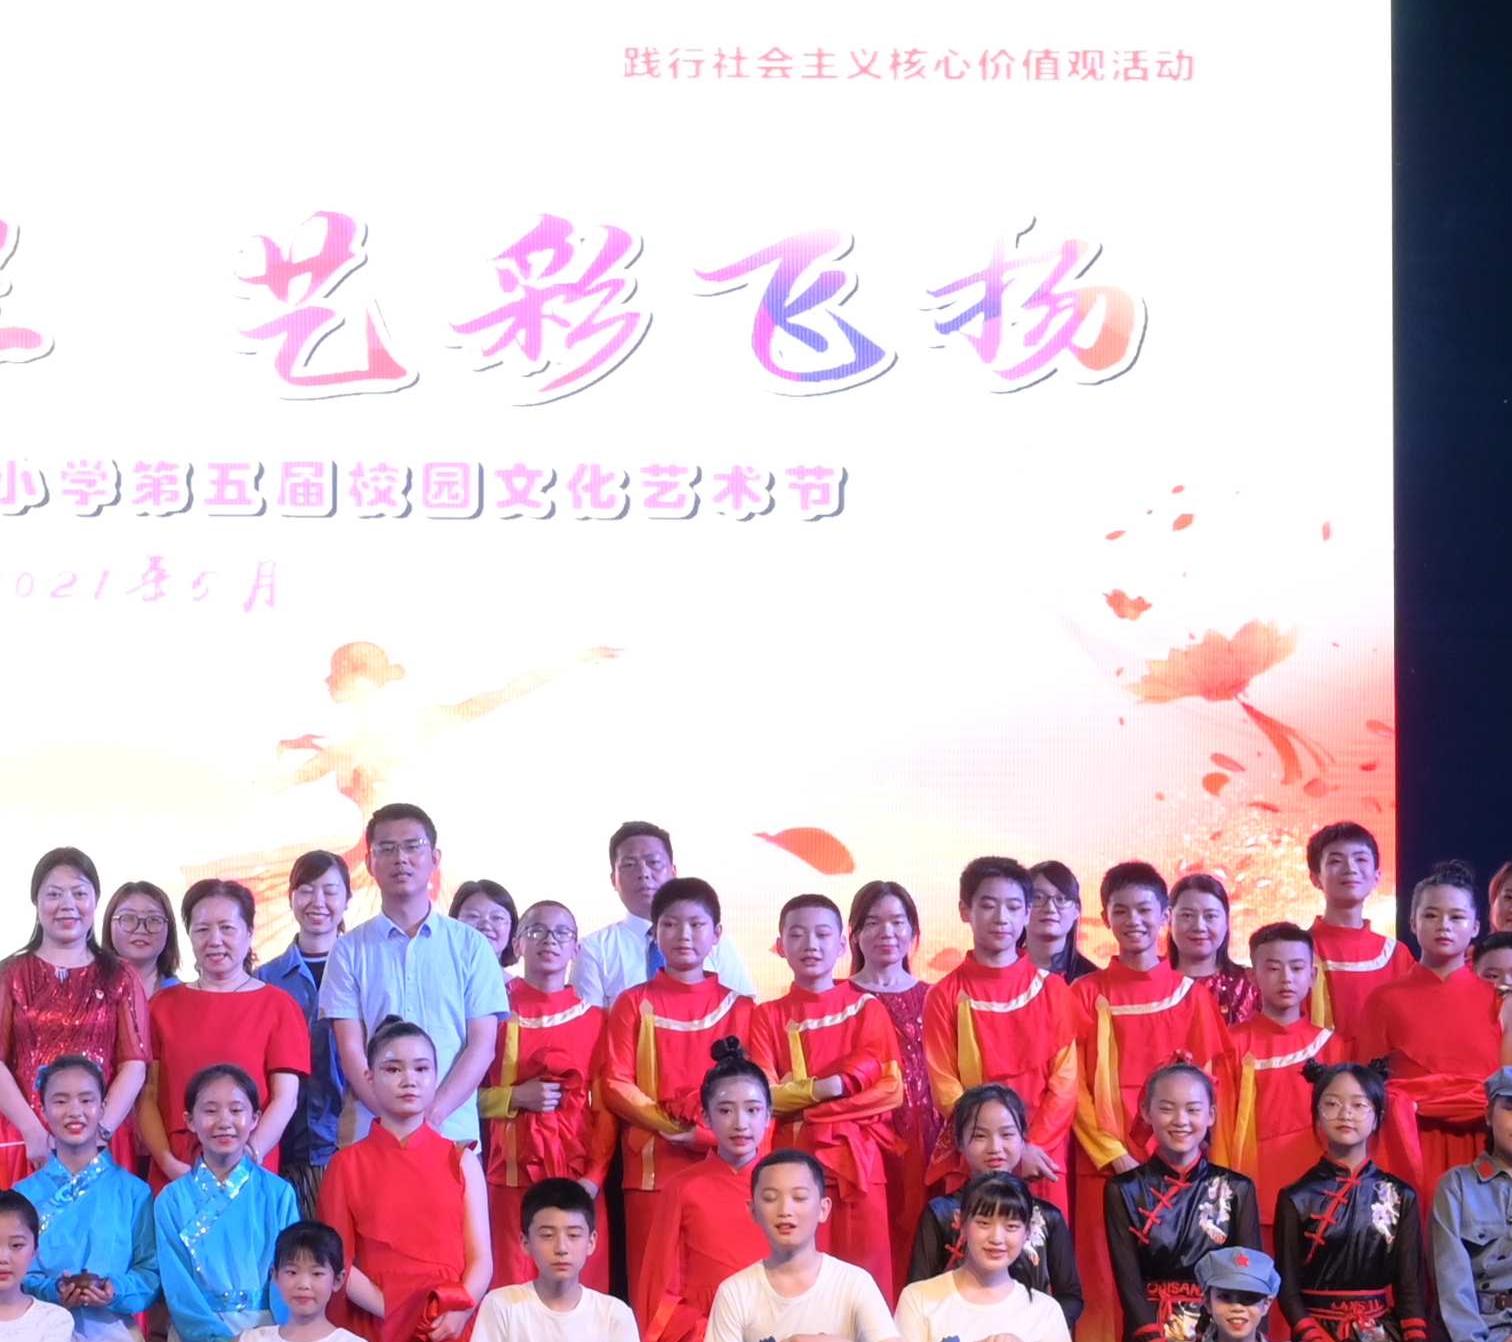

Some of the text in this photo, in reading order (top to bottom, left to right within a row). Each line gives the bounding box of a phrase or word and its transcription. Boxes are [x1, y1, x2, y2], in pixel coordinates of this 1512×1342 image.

[623, 46, 1195, 82] 践行社会主义核心价值观活动
[233, 209, 1148, 406] 艺彩飞扬
